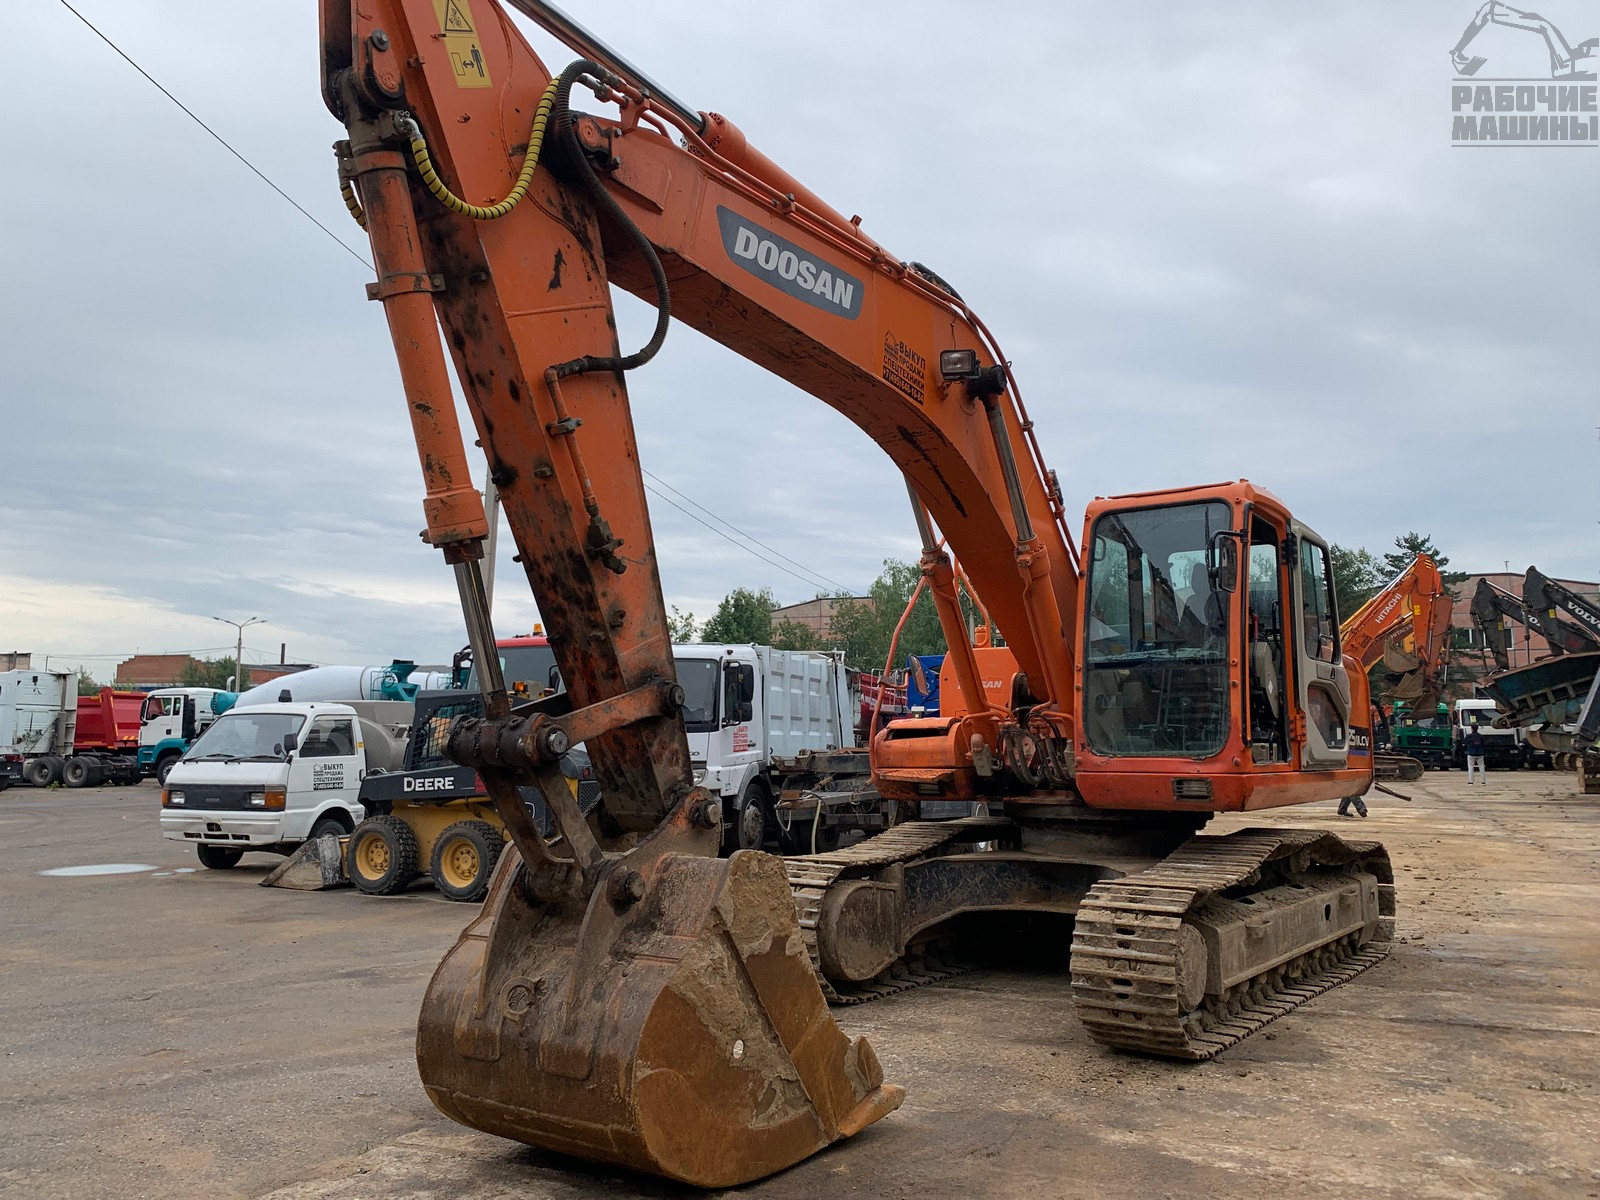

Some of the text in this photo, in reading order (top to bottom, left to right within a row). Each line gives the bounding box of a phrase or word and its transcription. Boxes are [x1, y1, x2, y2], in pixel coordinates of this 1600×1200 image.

[734, 226, 854, 309] DOOSAN
[899, 341, 926, 370] ВЫКУП
[899, 355, 925, 380] ПРОДАЖА
[884, 355, 925, 393] СПЕЦТЕХНИКИ
[1375, 593, 1403, 624] HITACHI
[403, 777, 455, 792] DEERE
